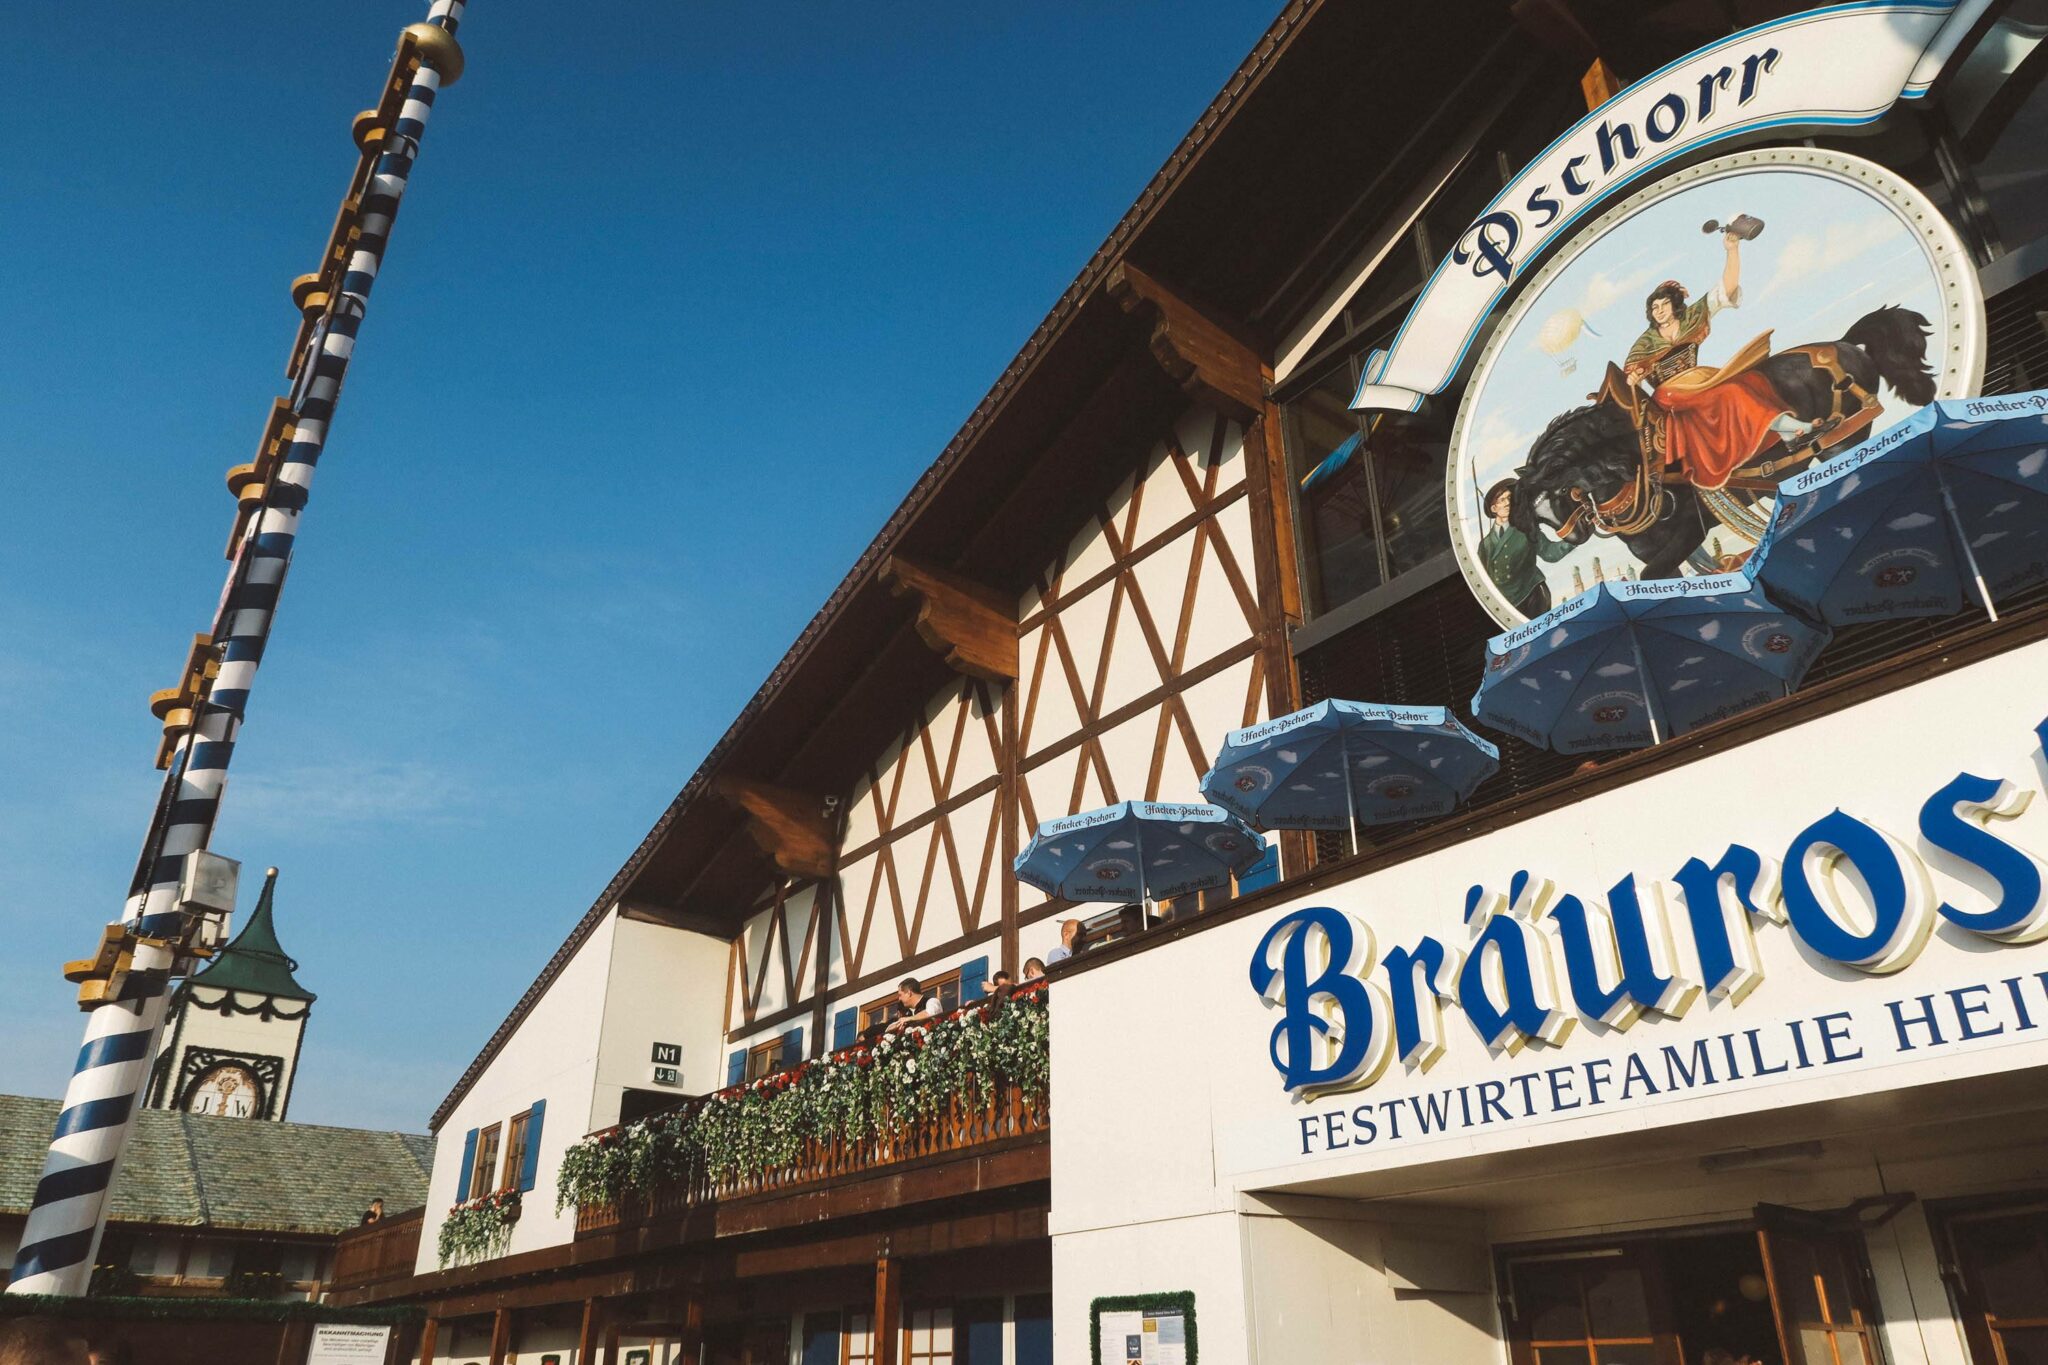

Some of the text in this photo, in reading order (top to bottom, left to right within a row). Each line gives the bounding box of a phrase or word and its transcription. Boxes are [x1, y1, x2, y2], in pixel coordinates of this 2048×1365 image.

[1453, 46, 1782, 284] Pschorr
[1966, 395, 2048, 417] Hacker-P
[1797, 425, 1912, 490] Hacker-Pschorr
[1625, 578, 1733, 597] Hacker-Pschorr
[1503, 596, 1585, 649] Hacker-Pschorr
[1240, 711, 1315, 743] Hacker-Pschorr
[1052, 811, 1117, 834] Hacker-Pschorr
[1144, 803, 1214, 818] Hacker-Pschorr
[1250, 715, 2048, 1098] Bräuros
[657, 1046, 676, 1062] N1
[1298, 970, 2048, 1155] FESTWIRTEFAMILIE HEI
